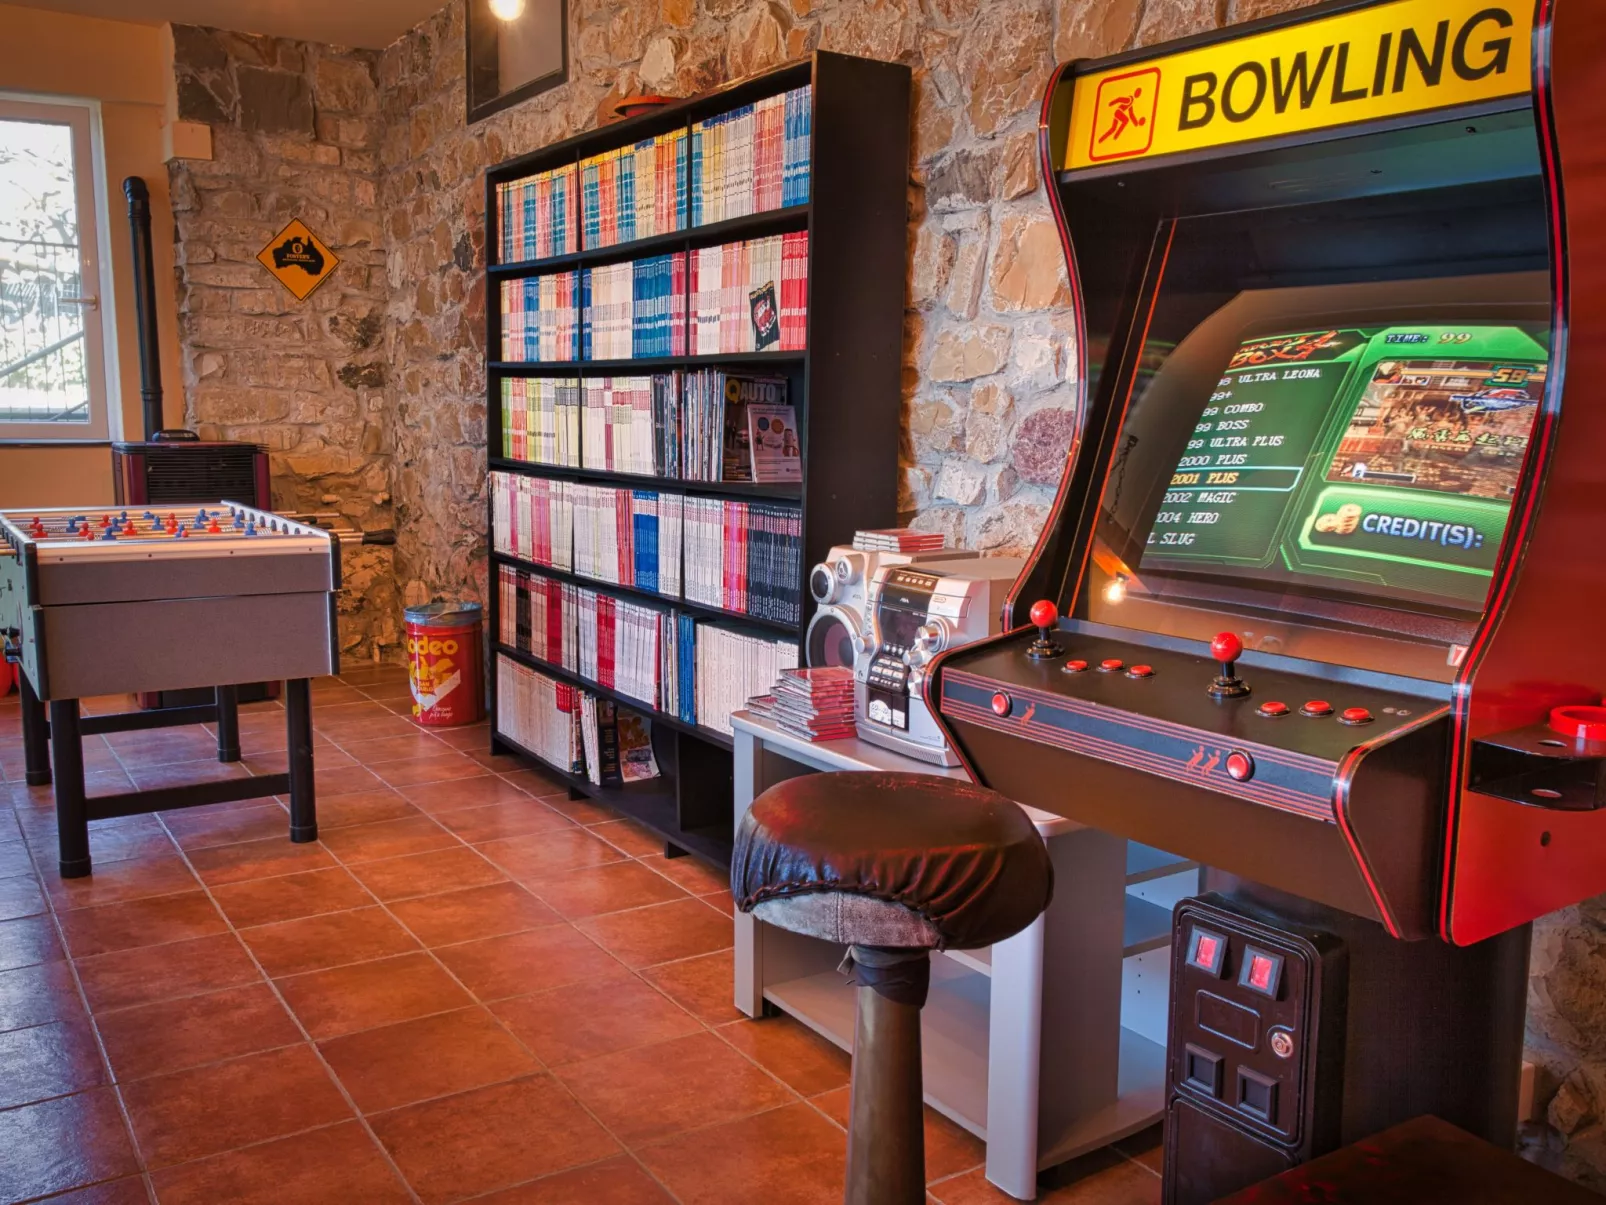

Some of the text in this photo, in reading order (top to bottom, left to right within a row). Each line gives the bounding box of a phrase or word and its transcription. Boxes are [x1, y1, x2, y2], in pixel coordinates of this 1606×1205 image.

[1178, 8, 1514, 131] BOWLING
[1437, 332, 1473, 344] 99
[1238, 372, 1277, 383] ULTRA
[1202, 402, 1264, 417] 99 COMBO
[1195, 419, 1250, 433] 99 BOSS
[1187, 435, 1285, 449] 99 ULTRA PLUS
[1178, 454, 1248, 467] 2000 PLUS
[1170, 472, 1239, 485] 2001 PLUS
[1197, 491, 1237, 503] MAGIC
[1155, 511, 1220, 524] 004 HERO
[1362, 513, 1485, 550] CREDIT(S):
[1160, 532, 1196, 545] SLUG
[407, 636, 459, 656] odeo
